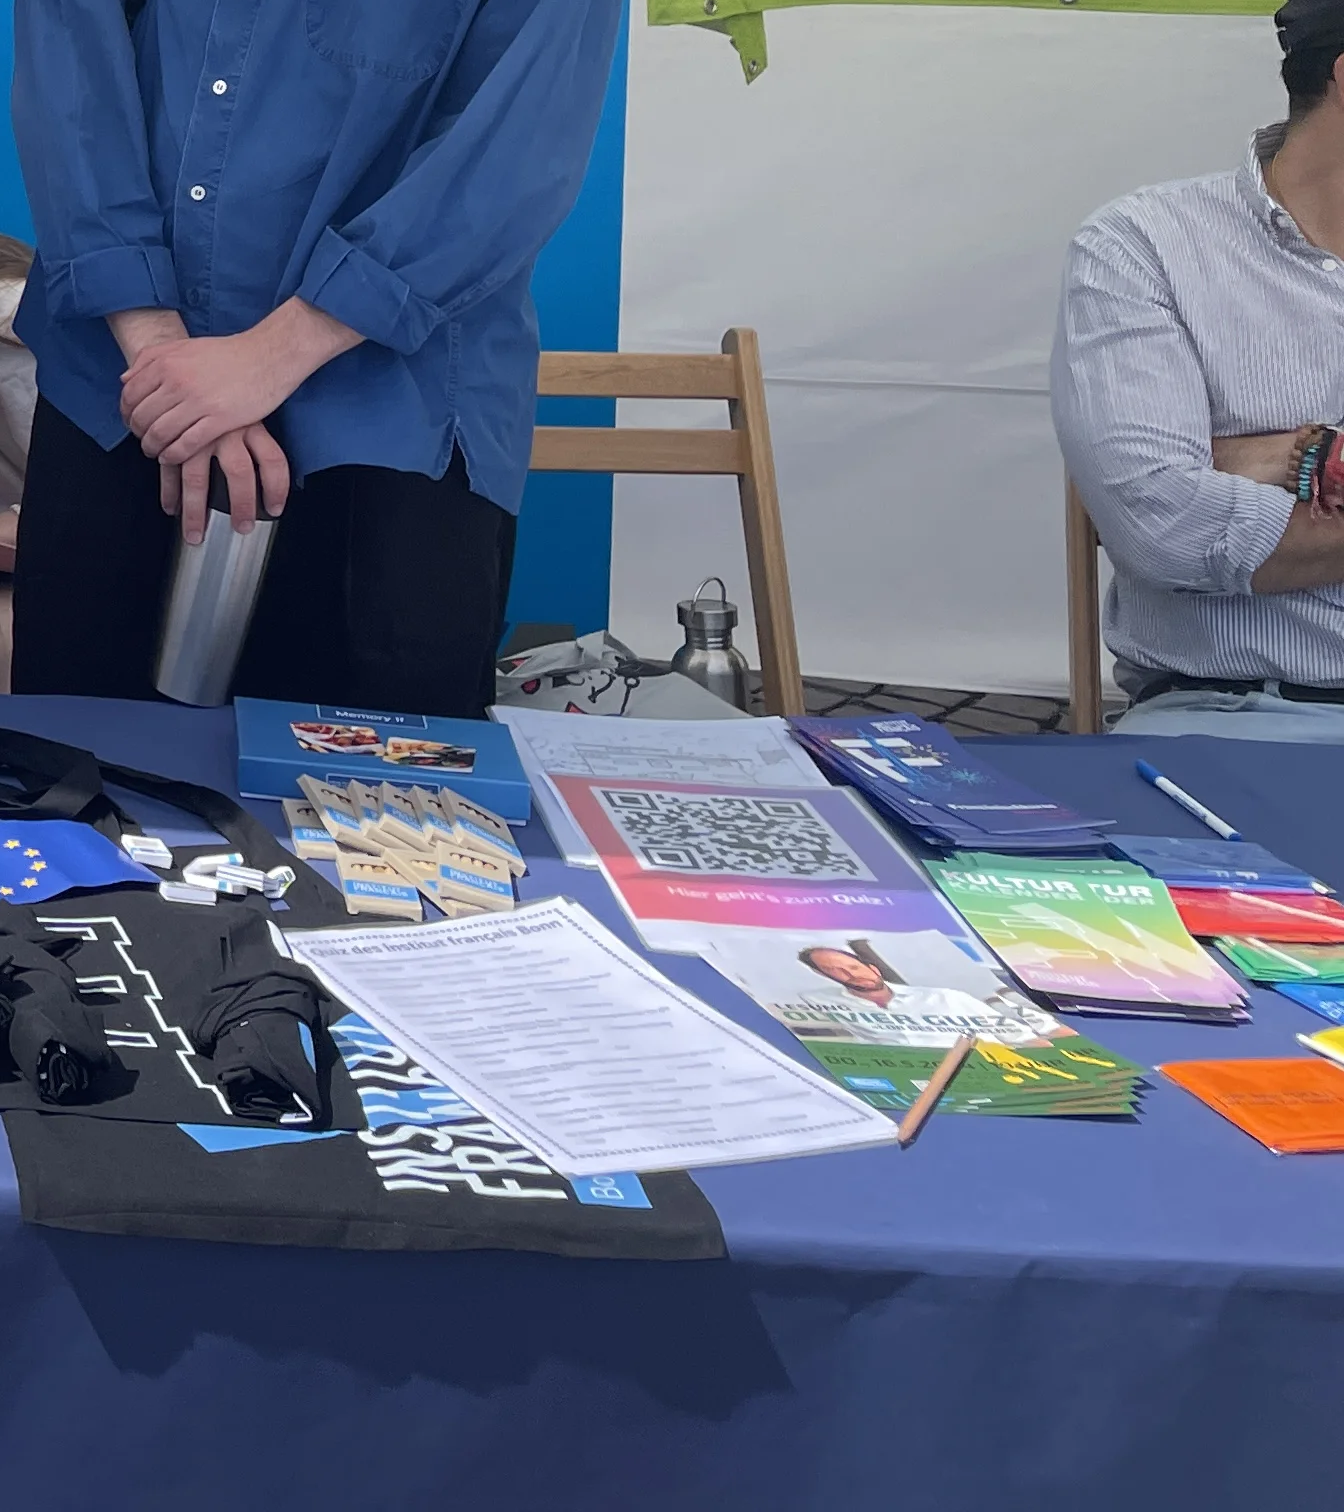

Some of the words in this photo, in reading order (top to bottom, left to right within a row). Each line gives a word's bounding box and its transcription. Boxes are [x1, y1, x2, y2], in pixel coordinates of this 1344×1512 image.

[335, 710, 392, 723] Memory
[939, 868, 1079, 893] KULTUR
[667, 885, 713, 900] Hier
[783, 894, 831, 905] zum
[832, 892, 884, 906] Quiz
[950, 882, 1085, 902] KALENDER
[309, 946, 349, 958] Quiz
[351, 943, 383, 955] des
[385, 938, 448, 953] Institut
[517, 919, 564, 937] Bonn
[774, 1002, 853, 1013] LESUNG
[782, 1010, 920, 1026] OLIVIER
[923, 1013, 1009, 1028] GUEZ
